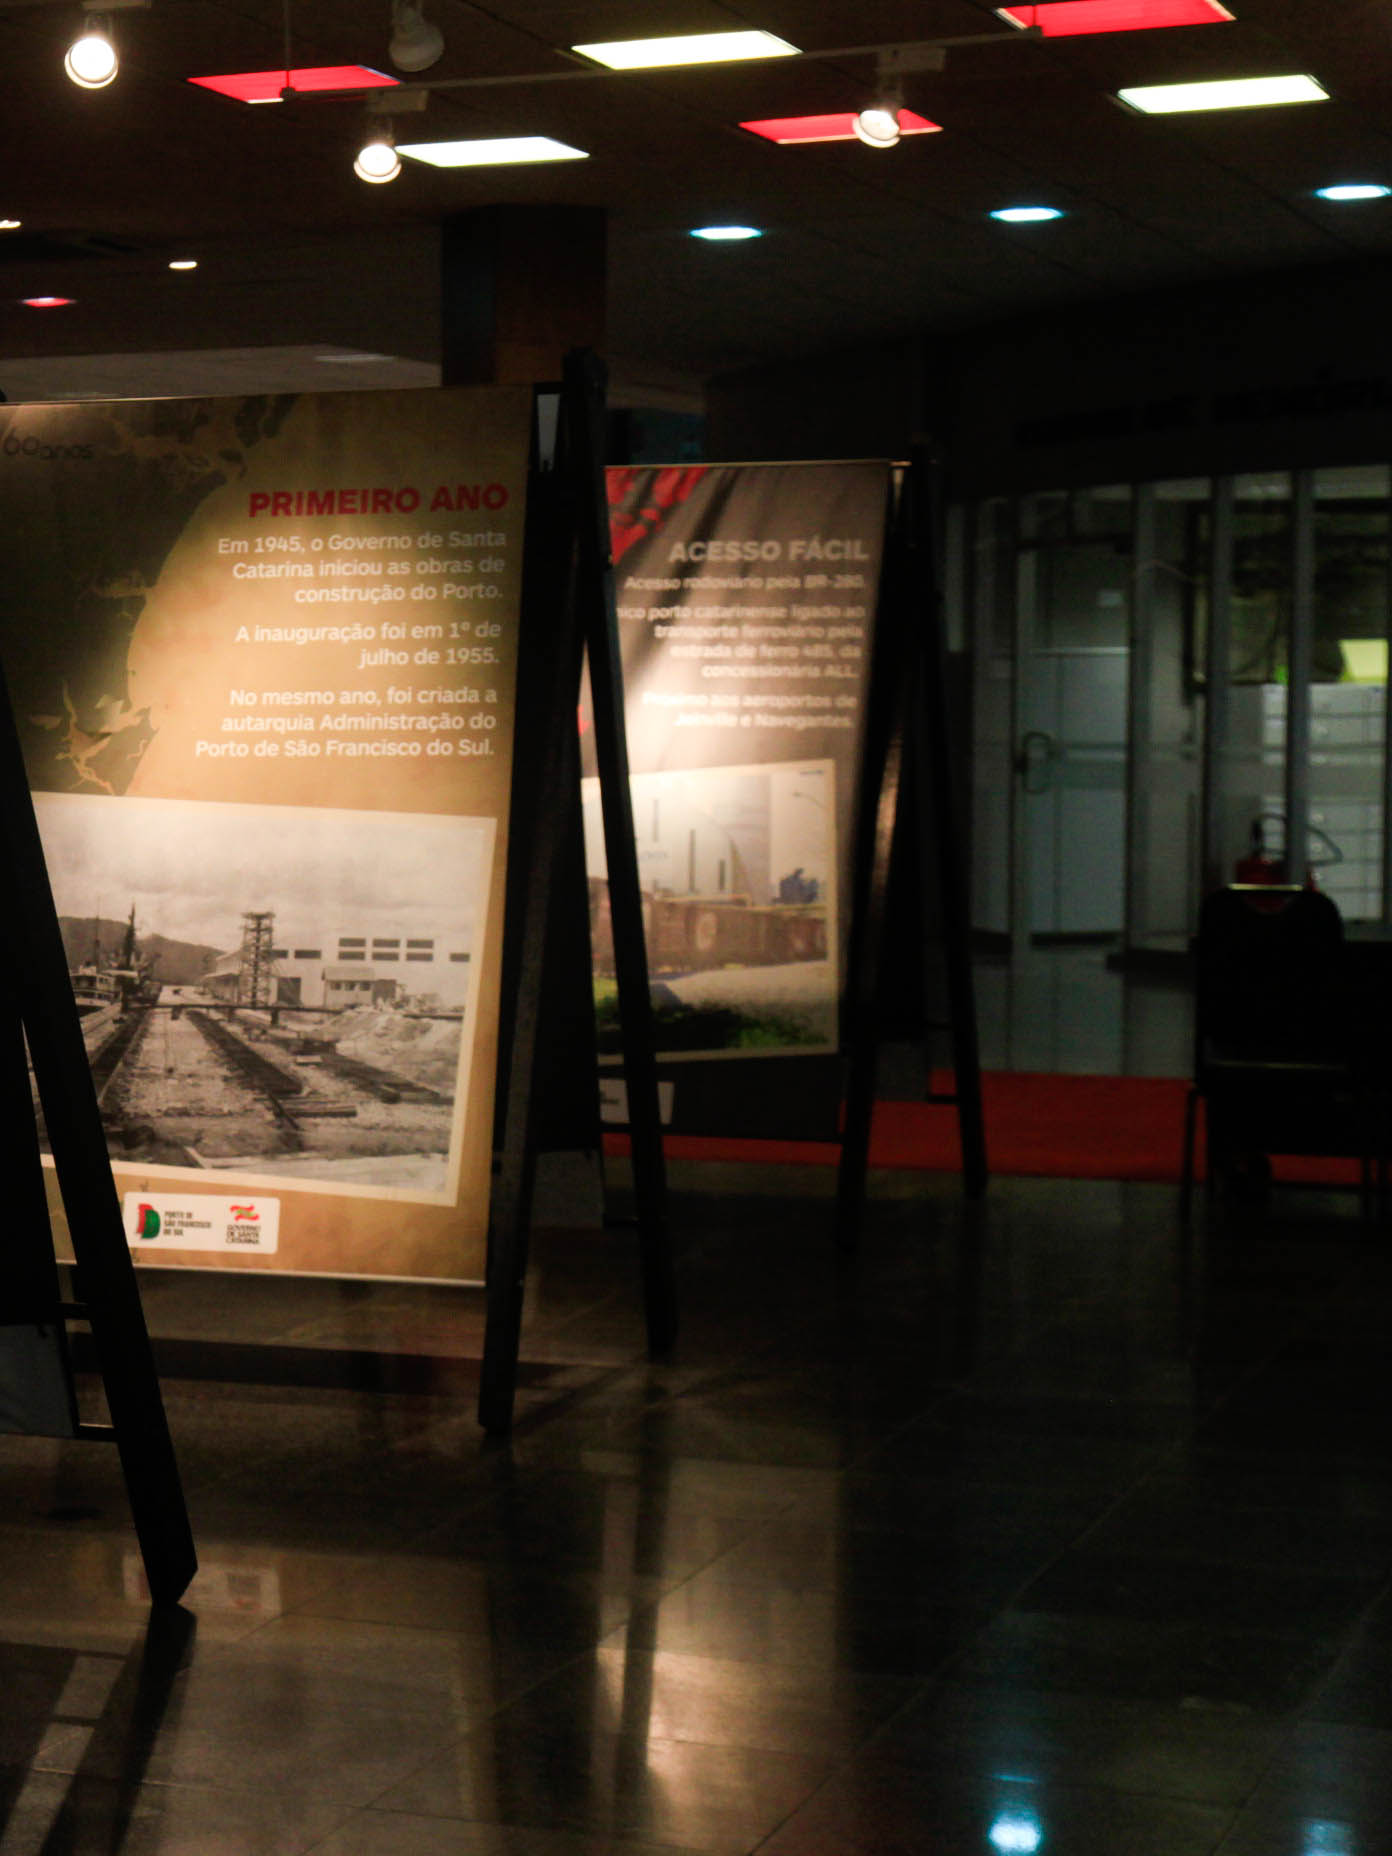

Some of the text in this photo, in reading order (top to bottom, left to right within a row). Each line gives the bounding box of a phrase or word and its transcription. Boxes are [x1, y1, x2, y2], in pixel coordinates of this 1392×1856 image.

[249, 484, 508, 517] PRIMEIRO ANO
[218, 530, 505, 554] Em 1945, o Governo de Santa
[669, 536, 869, 561] ACESSO FÁCIL
[233, 556, 504, 579] Catarina iniciou as obras de
[295, 583, 503, 604] construção do Porto.
[236, 626, 249, 642] A
[255, 623, 375, 644] inauguração
[381, 622, 406, 639] foi
[411, 624, 442, 638] em
[475, 622, 501, 638] de
[358, 648, 500, 669] julho de 1955.
[230, 687, 497, 706] No mesmo ano, foi criada a
[221, 713, 496, 734] autarquia Administração do
[196, 738, 494, 757] Porto de São Francisco do Sul.
